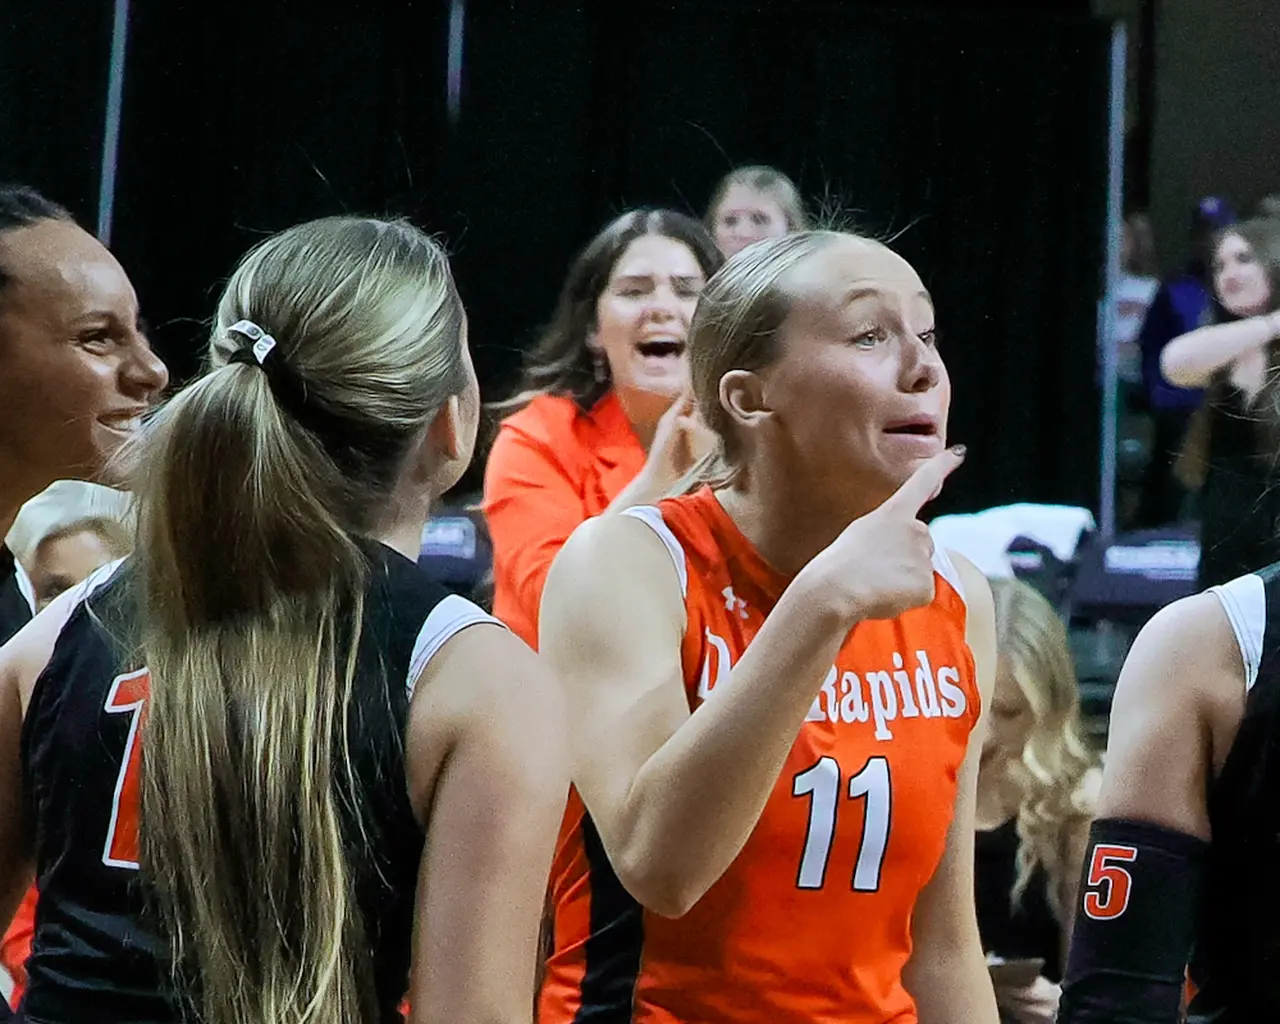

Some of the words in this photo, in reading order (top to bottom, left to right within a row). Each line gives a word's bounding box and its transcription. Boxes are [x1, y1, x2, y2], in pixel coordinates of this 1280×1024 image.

[804, 649, 967, 741] Rapids
[792, 754, 892, 893] 11
[1084, 844, 1138, 920] 5
